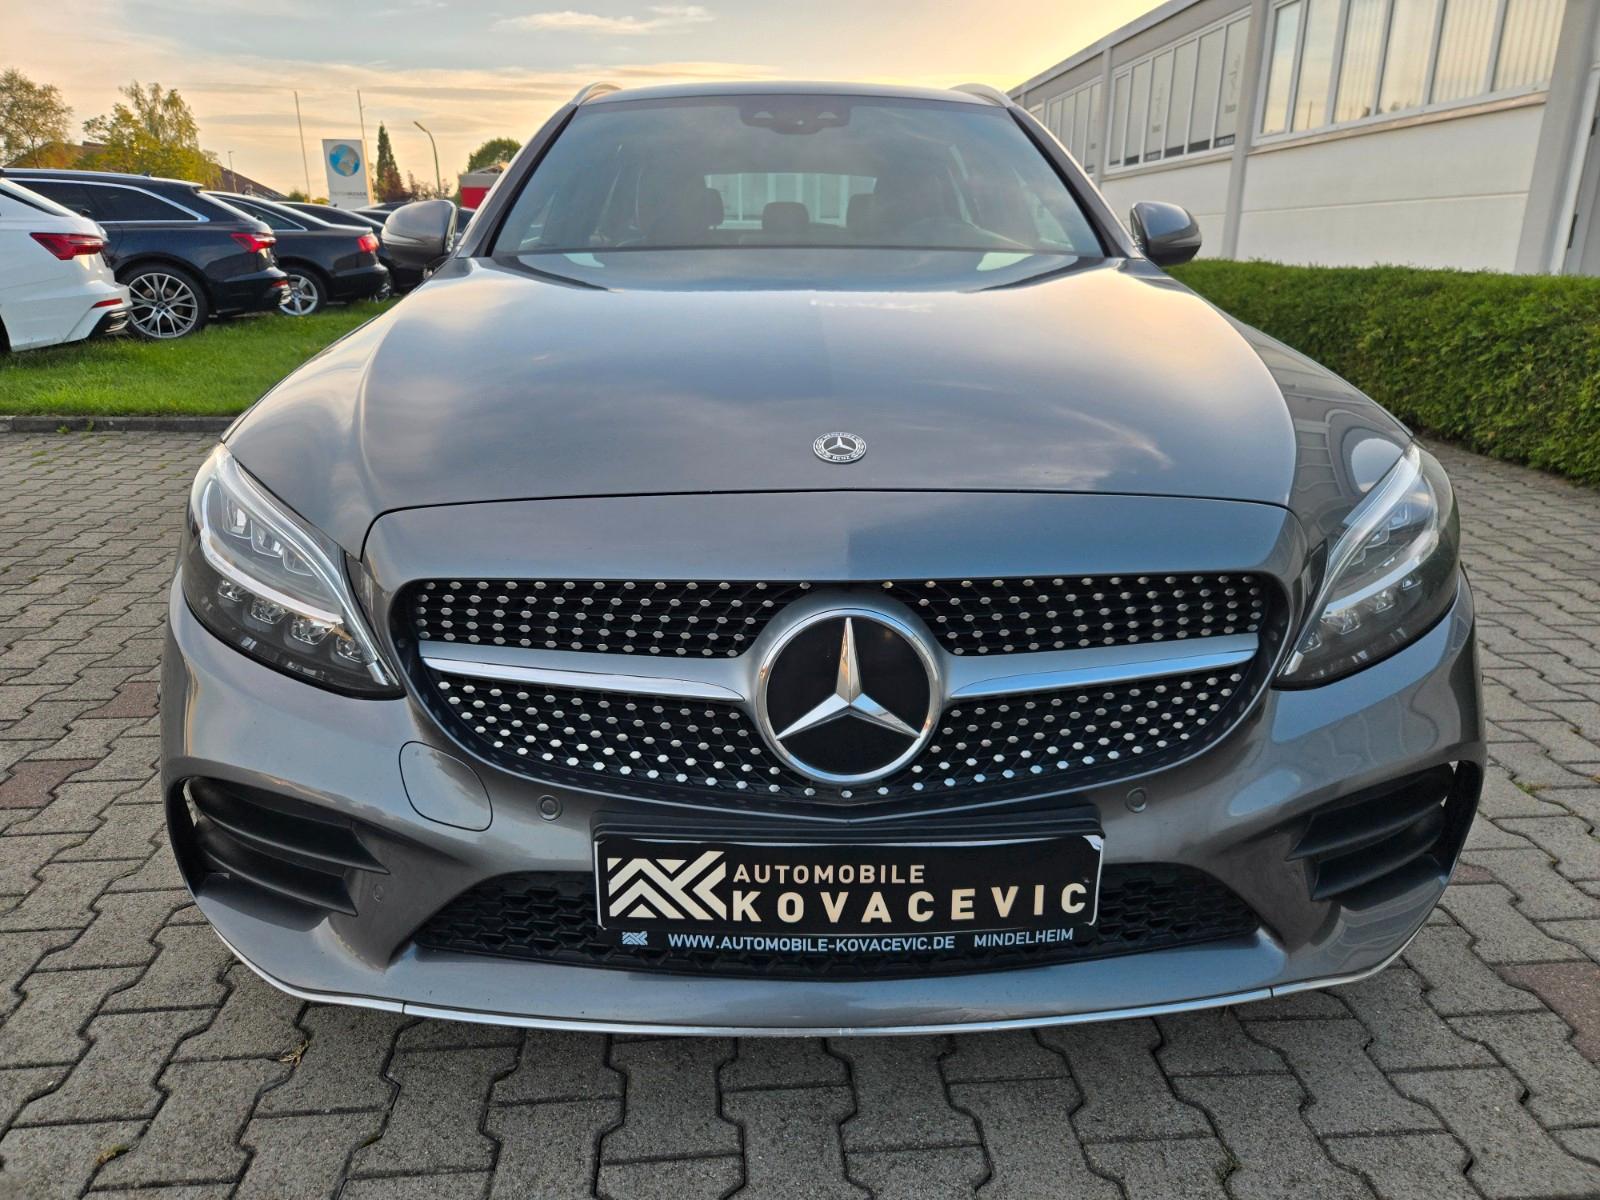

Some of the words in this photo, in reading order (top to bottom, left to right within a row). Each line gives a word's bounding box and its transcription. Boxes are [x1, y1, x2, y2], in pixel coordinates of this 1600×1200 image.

[733, 864, 925, 884] AUTOMOBILE
[733, 883, 1087, 923] KOVACEVIC
[668, 933, 955, 952] WWW.AUTOMOBILE-KOVACEVIC.DE
[974, 928, 1074, 948] MINDELHEIM
